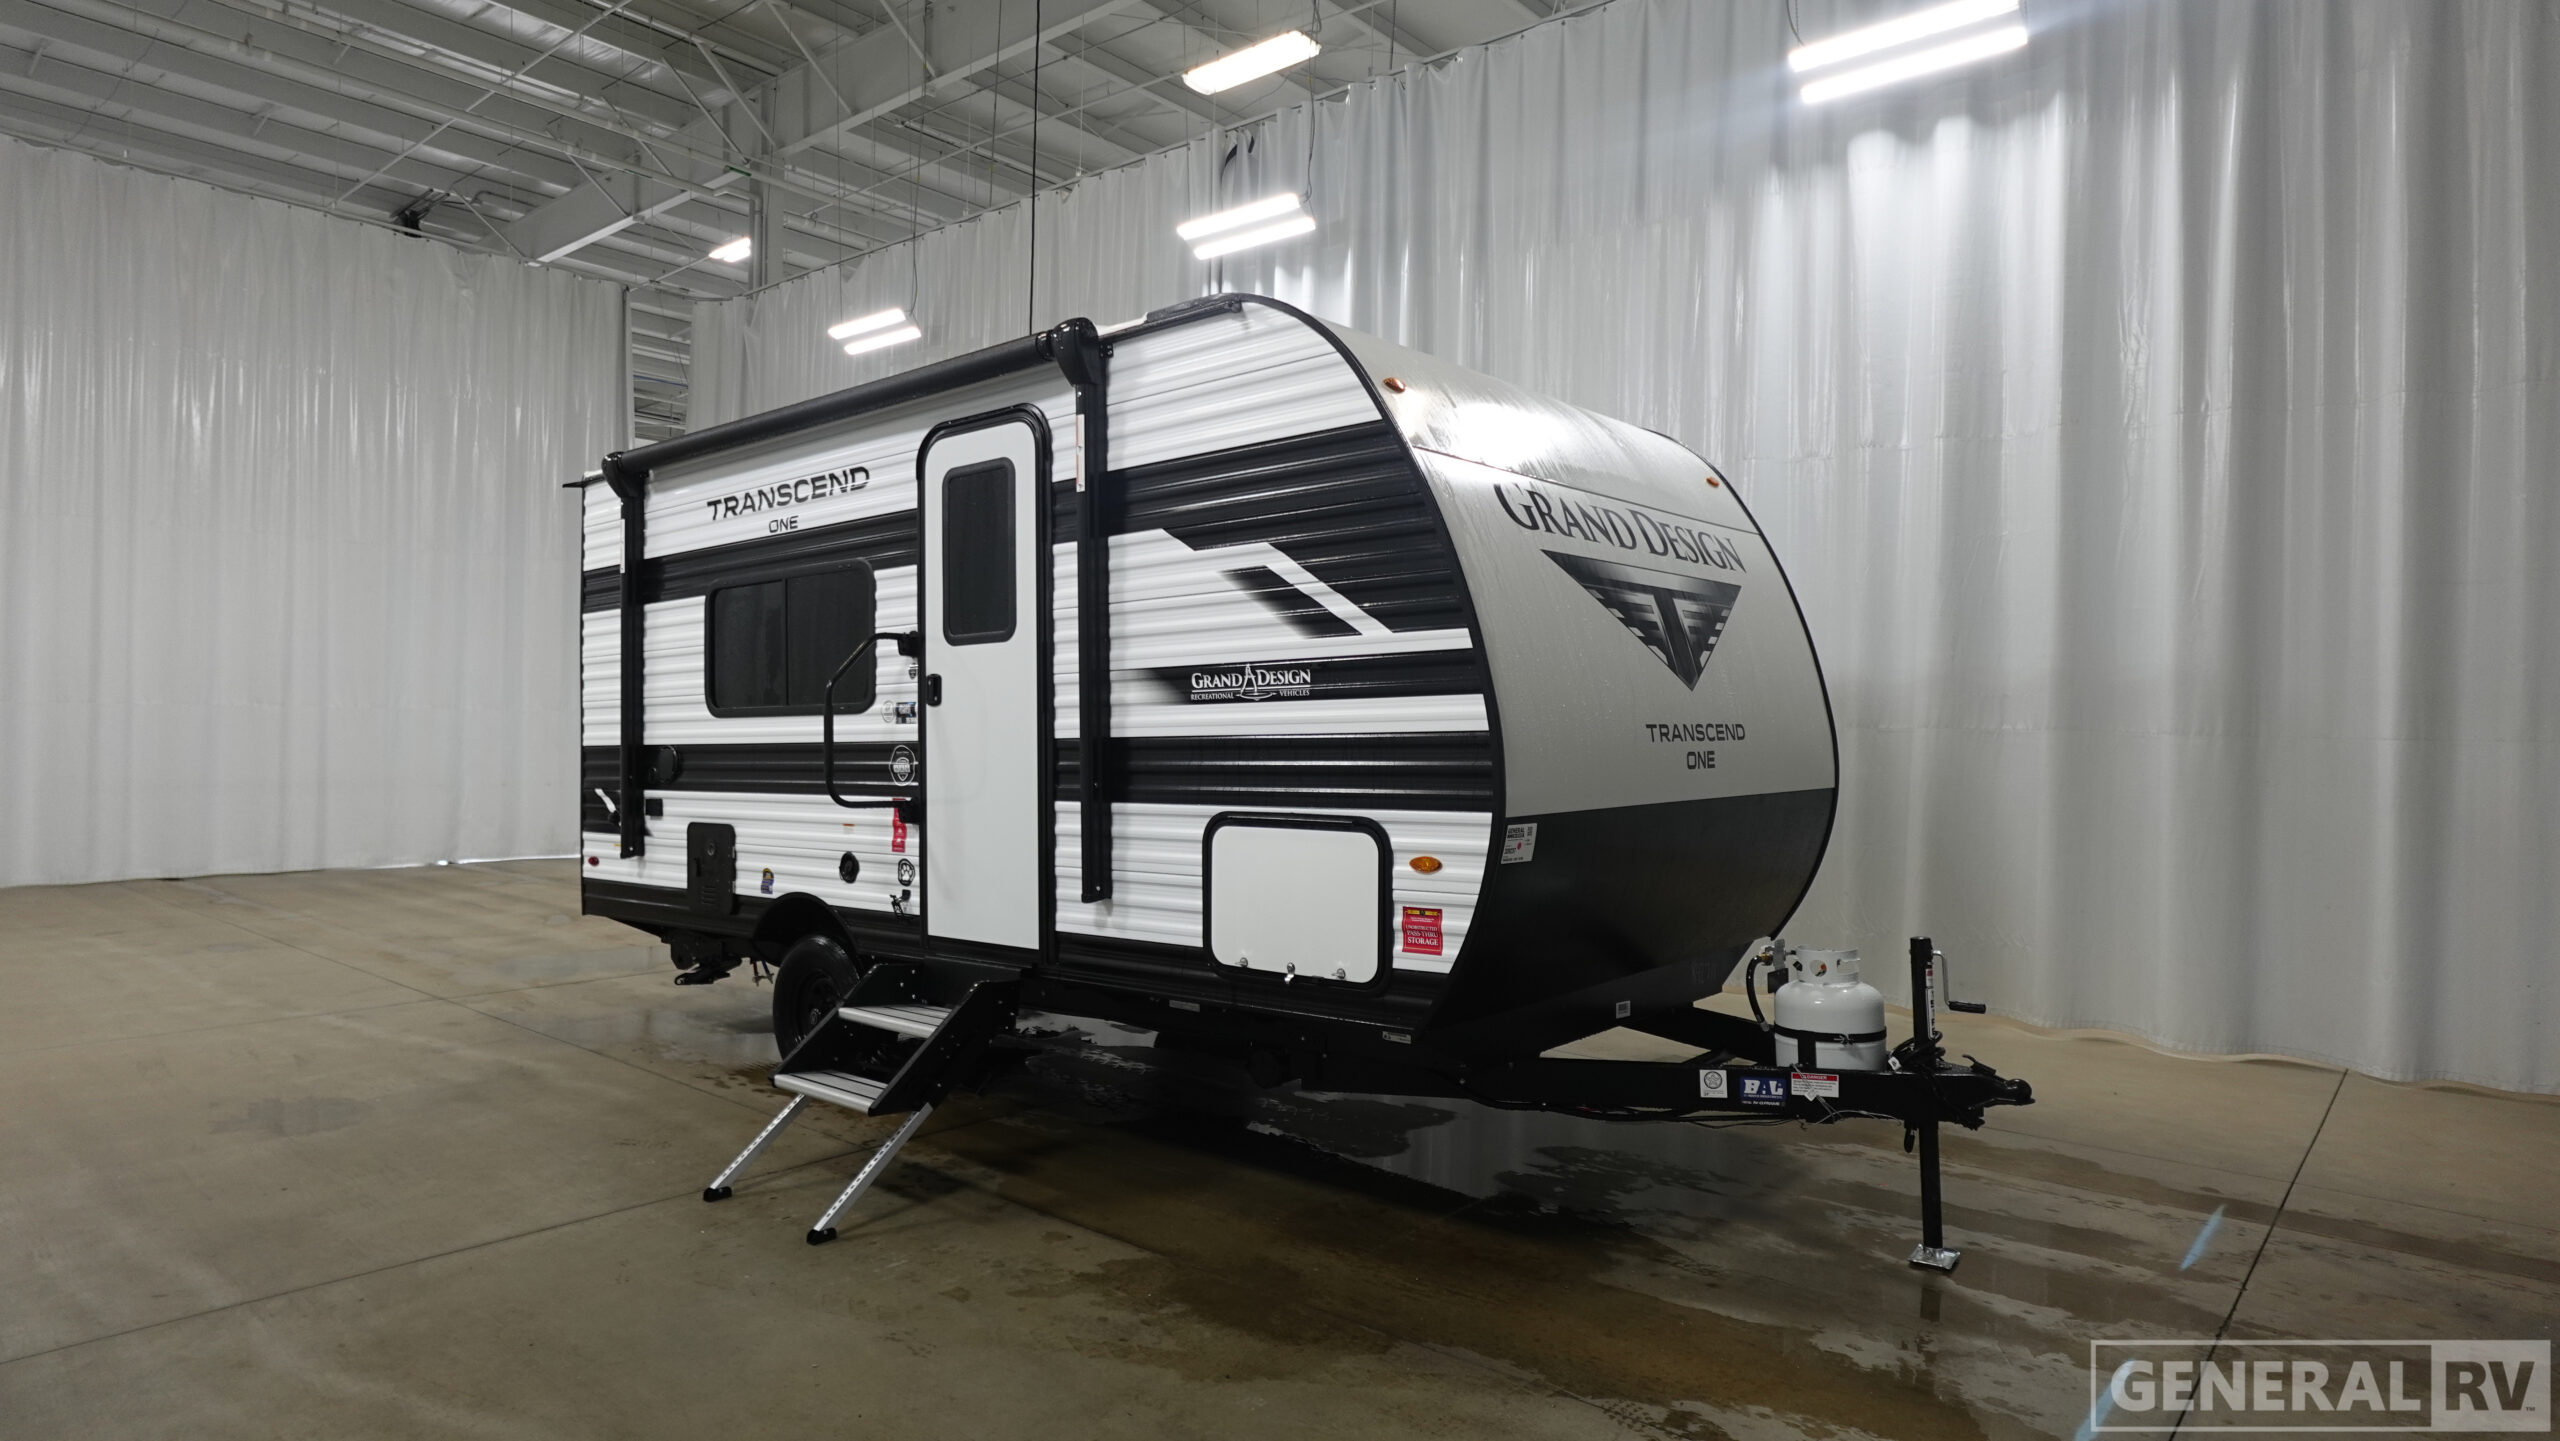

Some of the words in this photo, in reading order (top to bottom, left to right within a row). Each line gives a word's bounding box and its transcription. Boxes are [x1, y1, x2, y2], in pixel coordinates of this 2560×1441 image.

[707, 466, 870, 520] TRANSCEND
[768, 515, 799, 533] ONE
[1493, 483, 1638, 551] GRAND
[1625, 508, 1747, 573] DESIGN
[1191, 672, 1243, 689] GRAND
[1255, 669, 1311, 686] DESIGN
[1190, 691, 1234, 701] RECREATIONAL
[1279, 688, 1310, 697] VEHICLES
[1645, 723, 1746, 743] TRANSCEND
[1686, 750, 1716, 770] ONE
[1408, 937, 1438, 945] STORAGE
